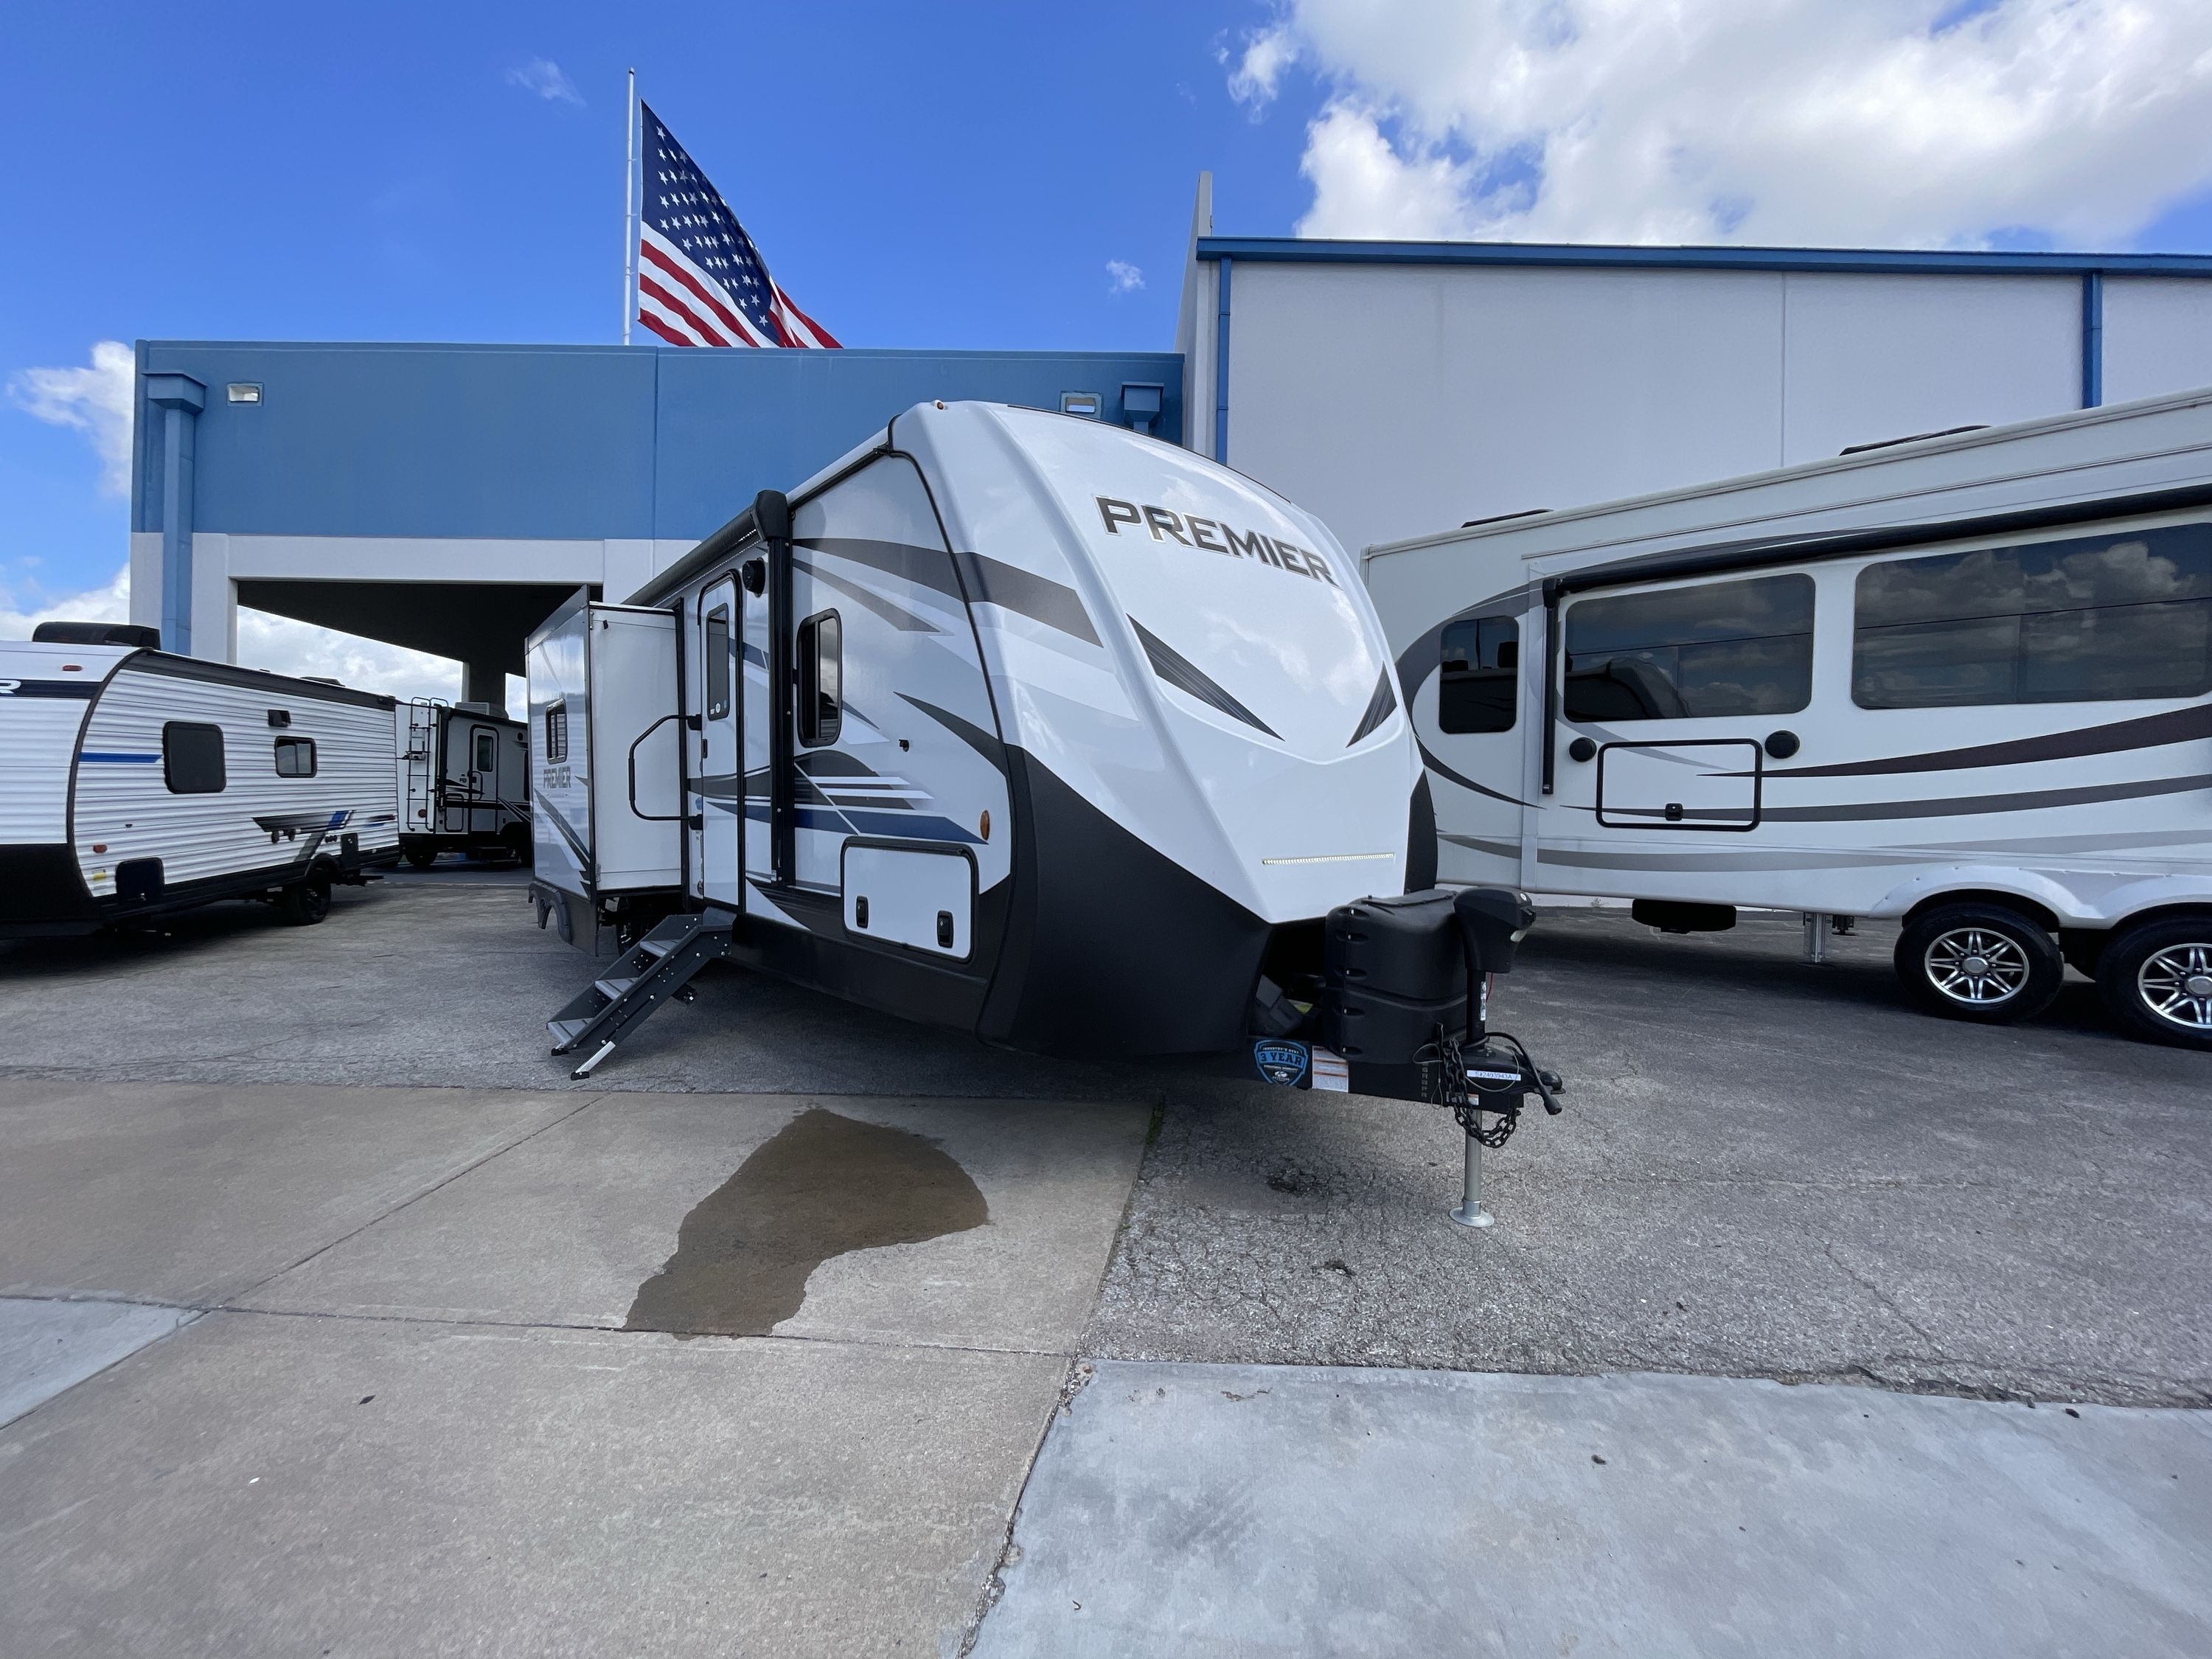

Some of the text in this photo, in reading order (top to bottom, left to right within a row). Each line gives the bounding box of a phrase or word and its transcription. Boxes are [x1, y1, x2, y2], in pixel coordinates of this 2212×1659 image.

[1093, 495, 1342, 589] PREMIER
[543, 766, 571, 788] PREMIER
[1260, 1052, 1302, 1066] 3 YEAR
